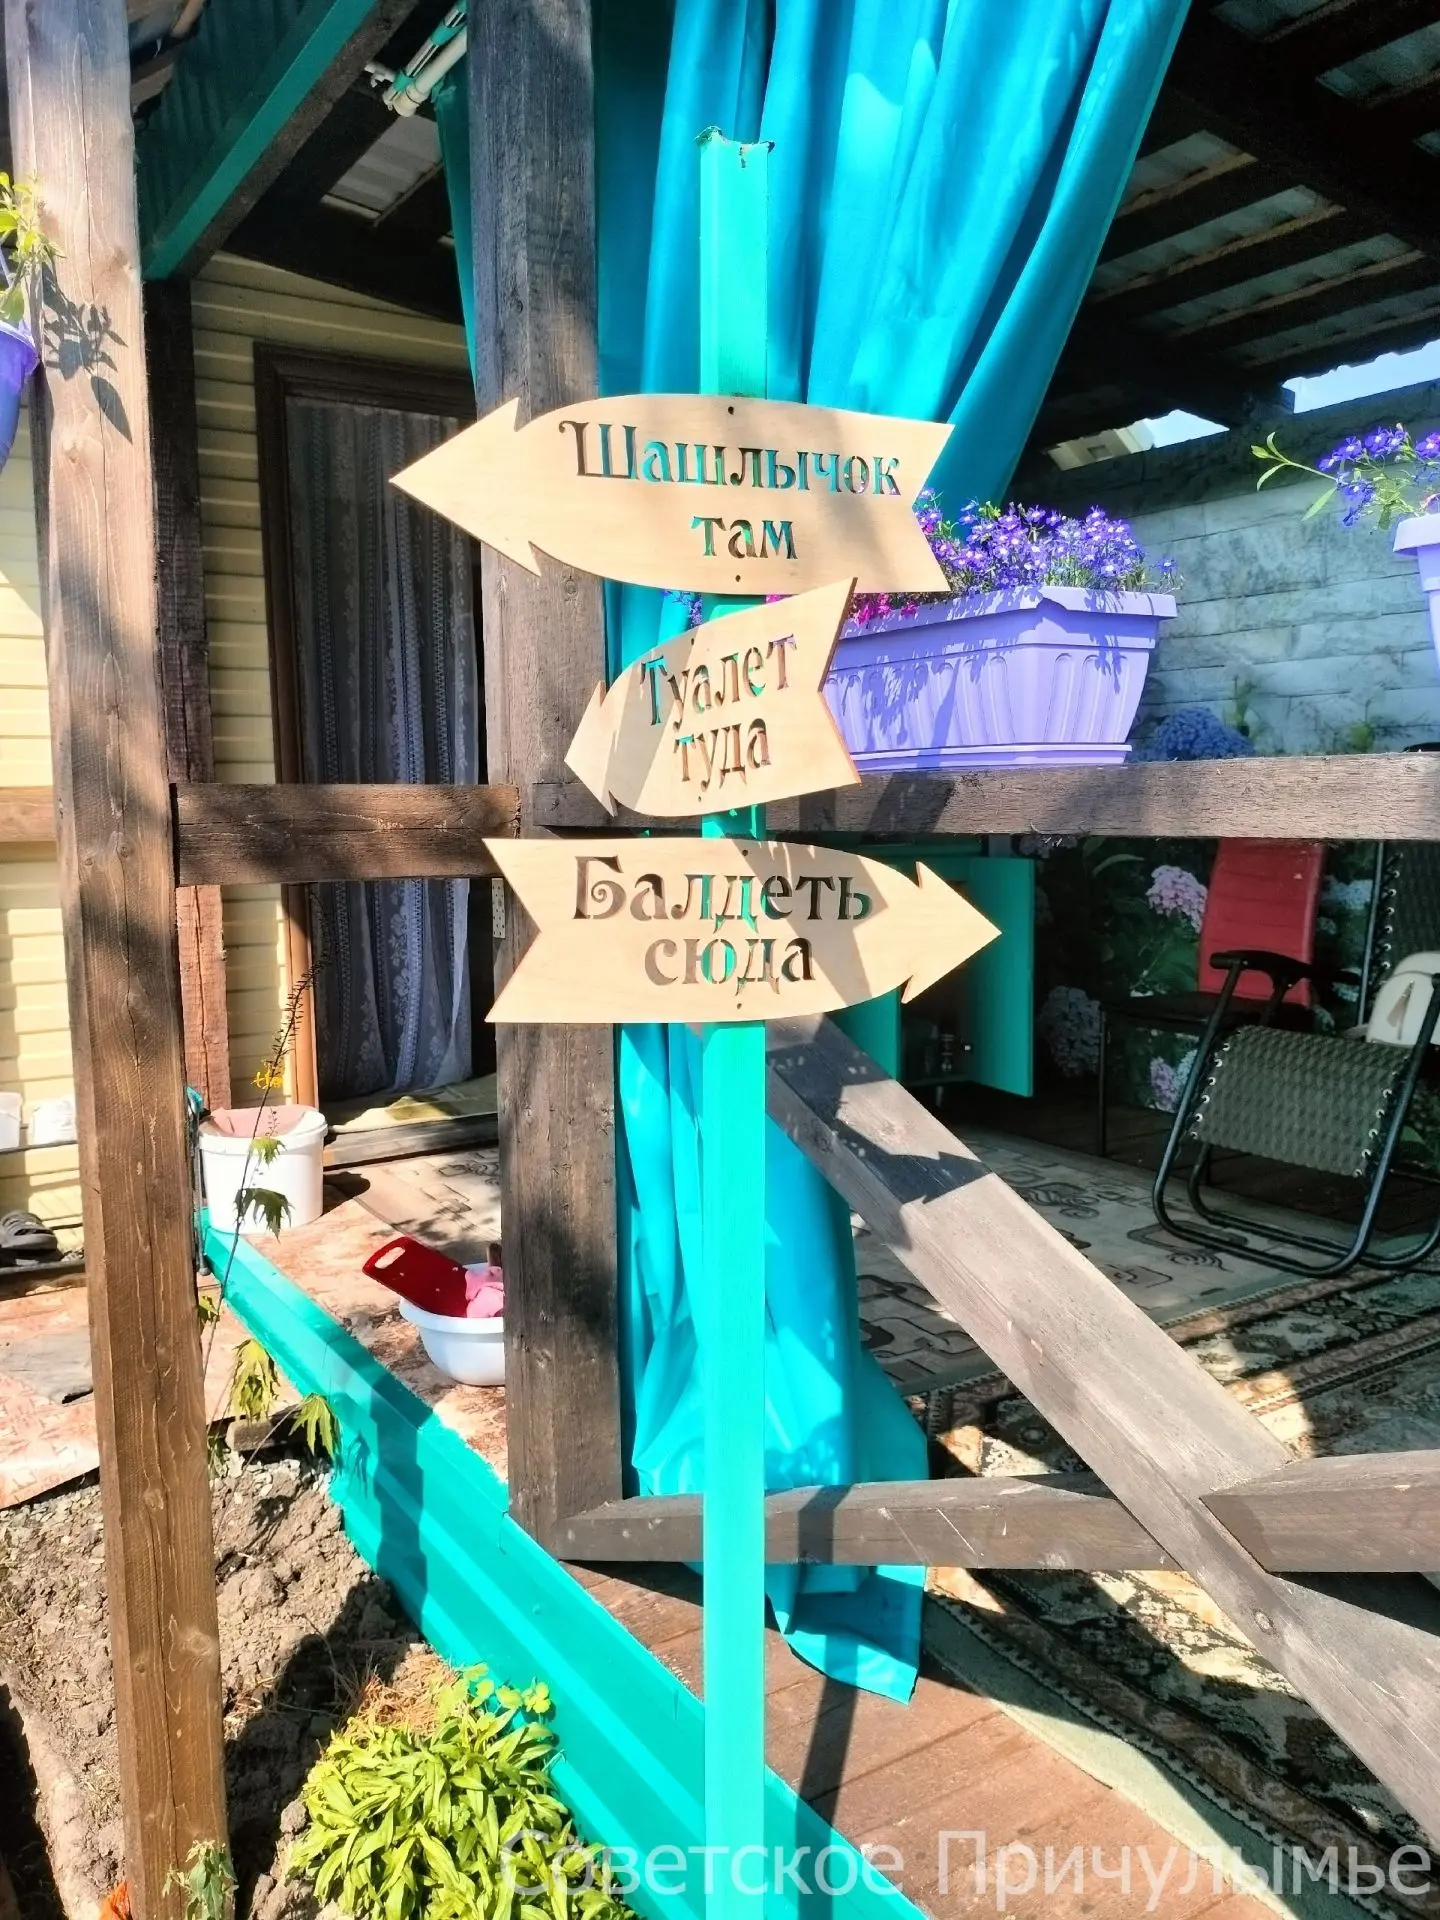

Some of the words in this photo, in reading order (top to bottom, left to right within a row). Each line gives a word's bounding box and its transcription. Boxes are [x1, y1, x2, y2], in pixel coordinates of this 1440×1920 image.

[558, 420, 901, 495] Шашлычок
[691, 516, 798, 559] там
[640, 634, 797, 732] Туалет
[673, 718, 771, 792] туда
[573, 855, 873, 933] Балдеть
[644, 937, 816, 996] сюда
